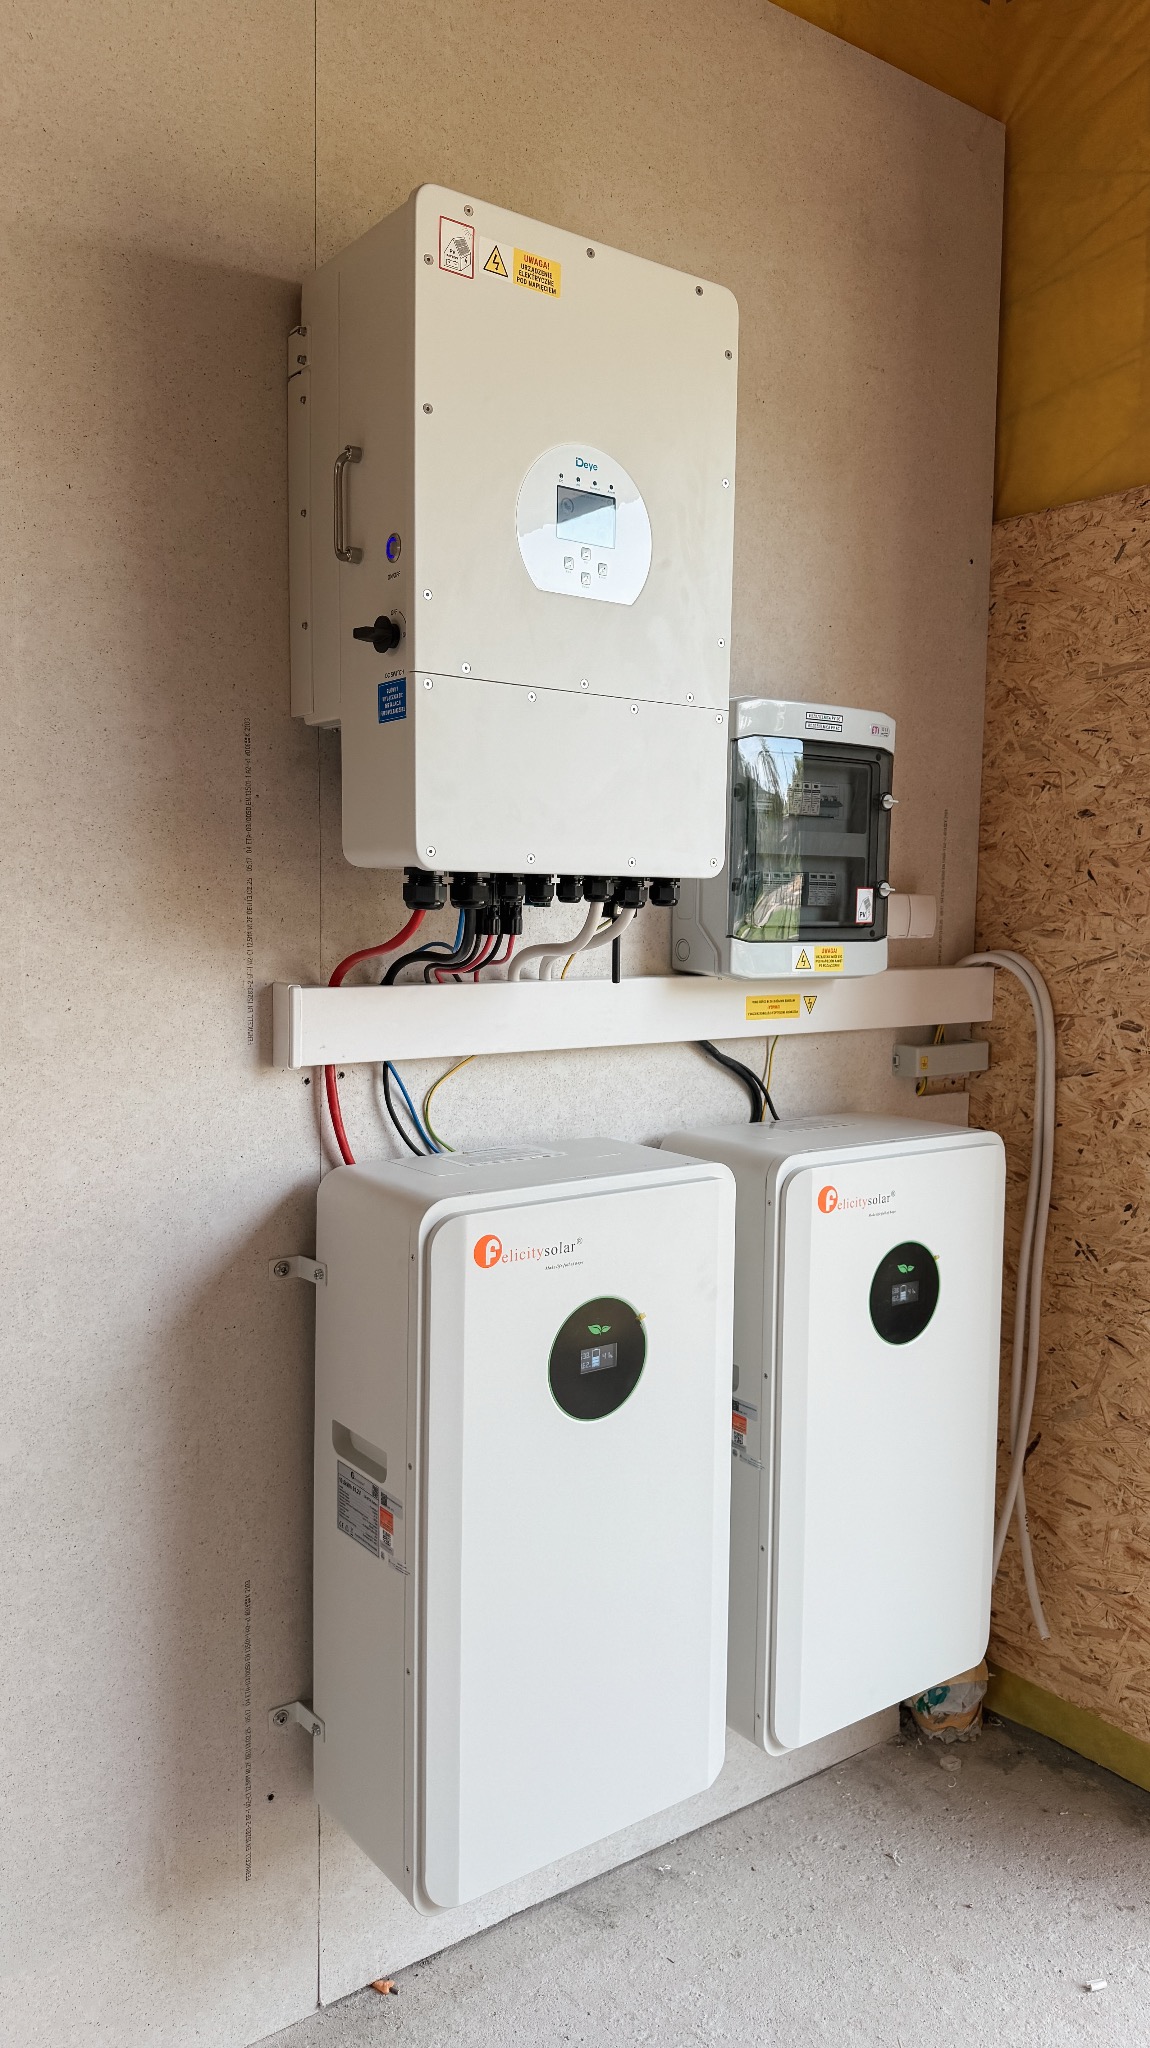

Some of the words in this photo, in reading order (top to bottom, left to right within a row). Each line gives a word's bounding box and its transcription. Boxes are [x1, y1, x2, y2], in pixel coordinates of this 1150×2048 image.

[523, 254, 550, 270] UWAGA!
[516, 275, 528, 285] POD
[528, 280, 557, 295] NAPIĘCIEM
[518, 269, 555, 287] ELEKTRYCZNE
[575, 456, 599, 471] Deye
